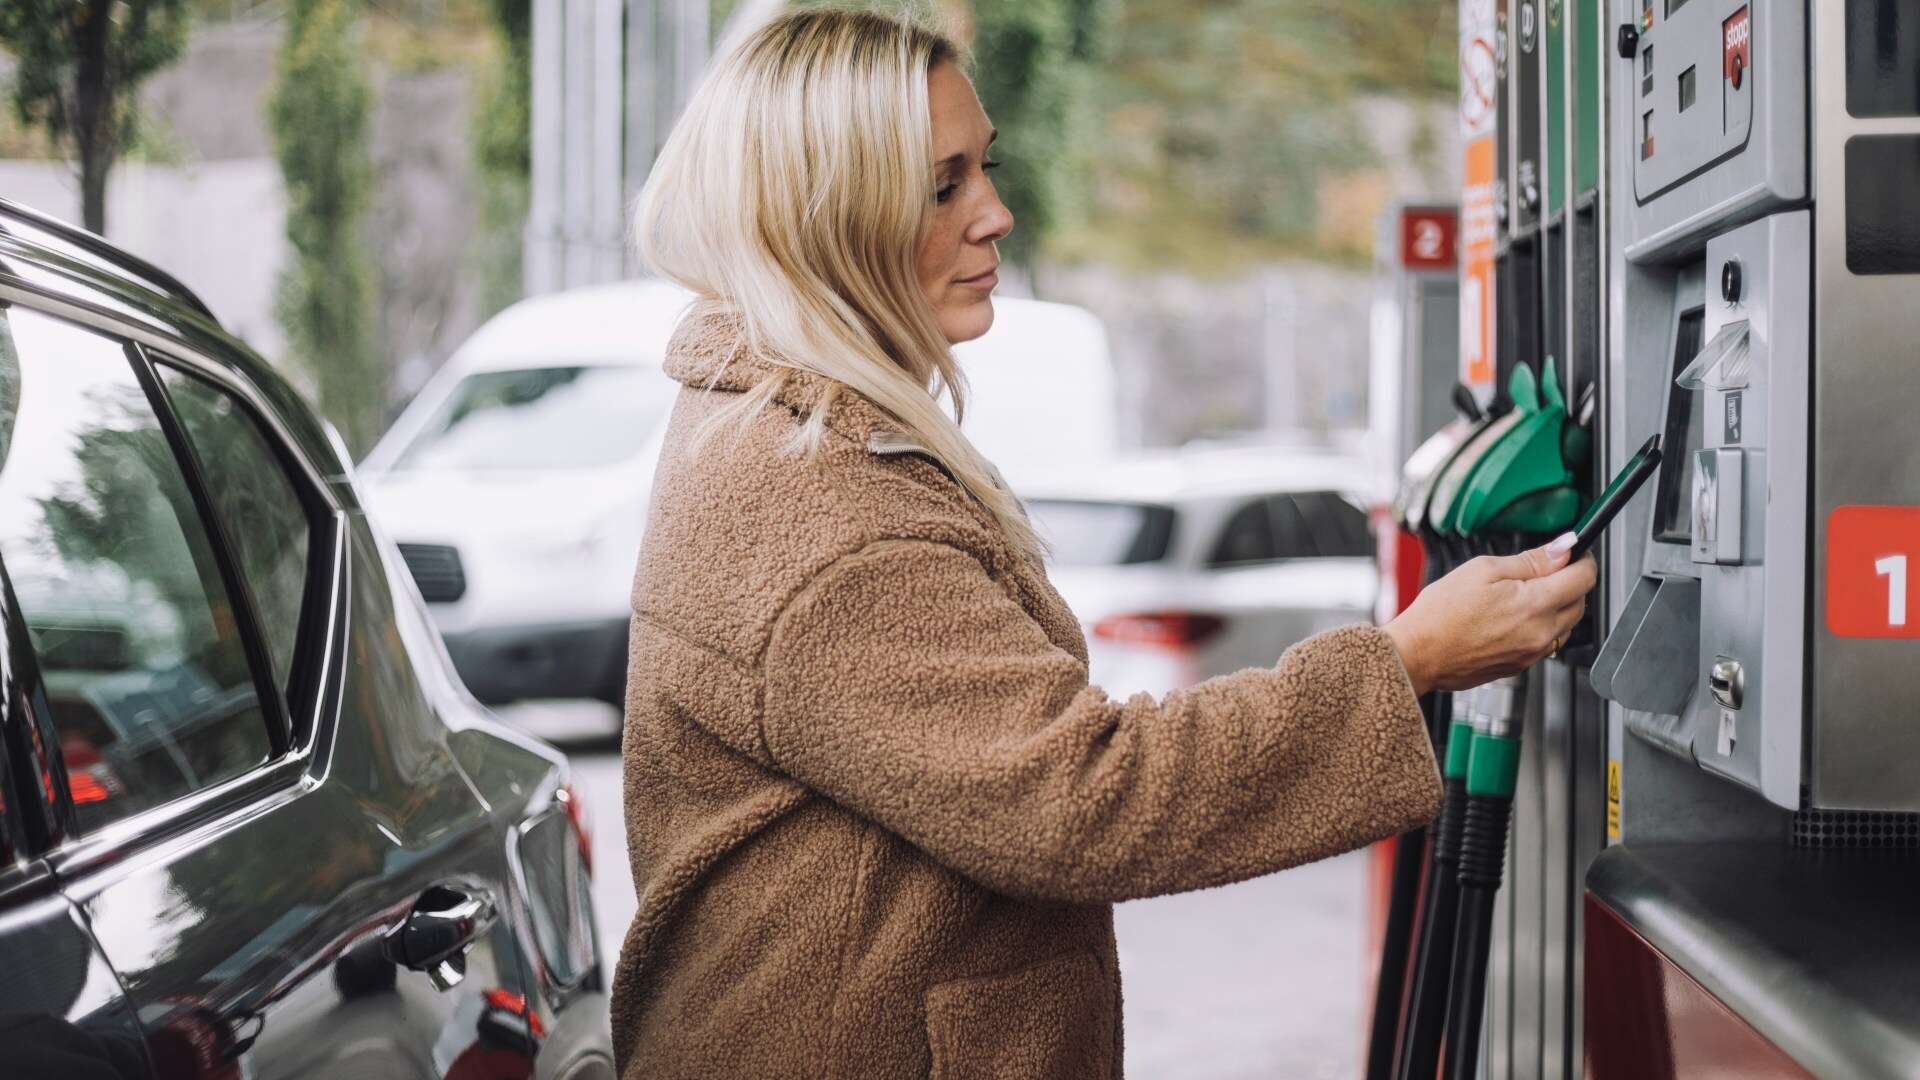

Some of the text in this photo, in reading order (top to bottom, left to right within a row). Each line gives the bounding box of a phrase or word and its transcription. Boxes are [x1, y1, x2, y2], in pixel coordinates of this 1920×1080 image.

[1727, 17, 1748, 50] stopp
[1413, 219, 1443, 259] 2
[1875, 555, 1907, 625] 1
